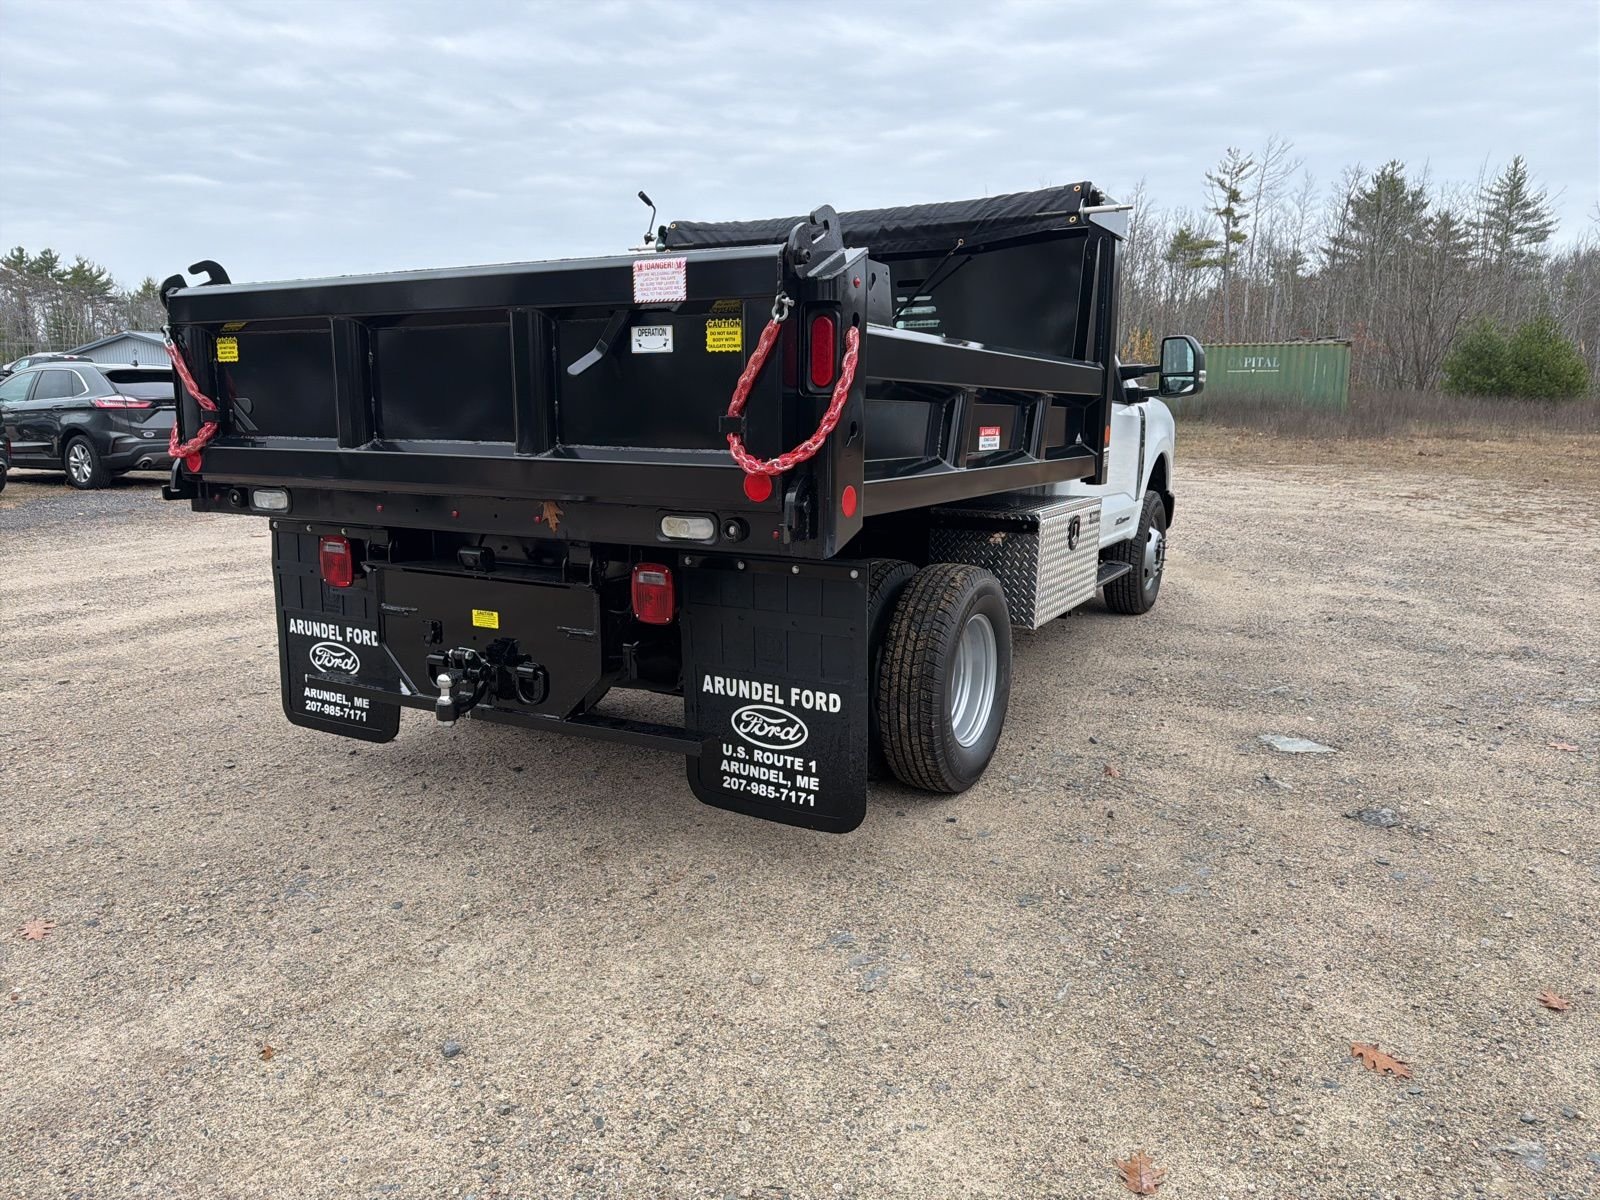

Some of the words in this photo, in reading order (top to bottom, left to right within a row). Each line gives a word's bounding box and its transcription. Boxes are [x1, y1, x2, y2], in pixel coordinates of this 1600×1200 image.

[638, 328, 667, 336] OPERATION
[290, 618, 343, 641] ARUNDEL
[314, 646, 356, 670] Ford
[304, 686, 351, 707] ARUNDEL,
[354, 697, 370, 709] ME
[702, 674, 784, 705] ARUNDEL
[790, 687, 841, 713] FORD
[305, 700, 367, 722] 207-985-7171
[739, 710, 802, 742] Ford
[722, 744, 750, 760] U.S.
[754, 750, 804, 771] ROUTE
[808, 760, 816, 773] 1
[720, 760, 792, 787] ARUNDEL,
[796, 775, 820, 791] ME
[722, 776, 815, 807] 207-985-7171
